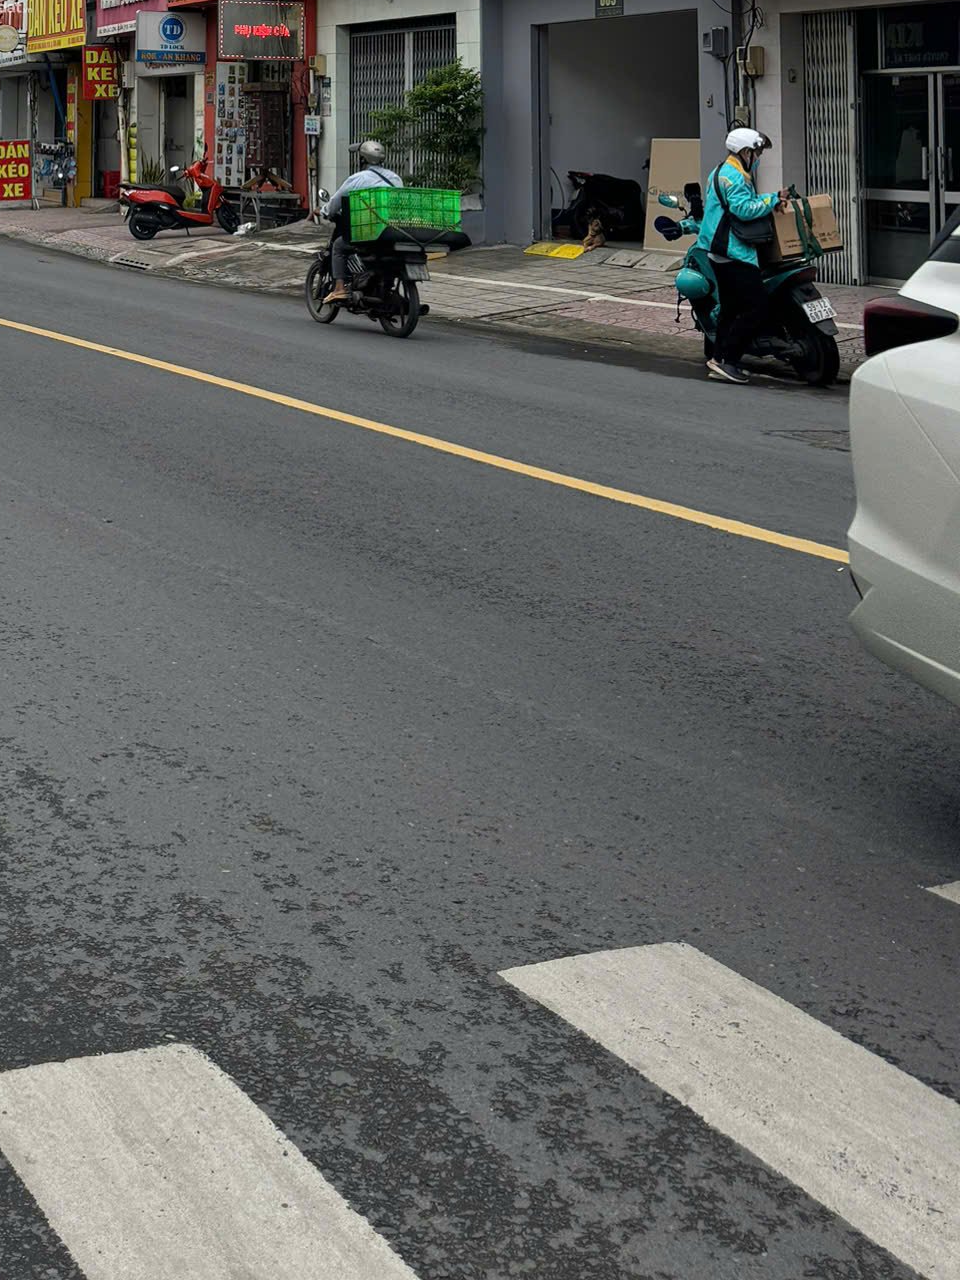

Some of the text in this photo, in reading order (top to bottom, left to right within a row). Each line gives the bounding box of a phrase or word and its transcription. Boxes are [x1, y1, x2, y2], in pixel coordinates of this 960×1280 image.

[164, 24, 180, 35] TD
[94, 83, 120, 98] XE
[2, 183, 25, 198] XE
